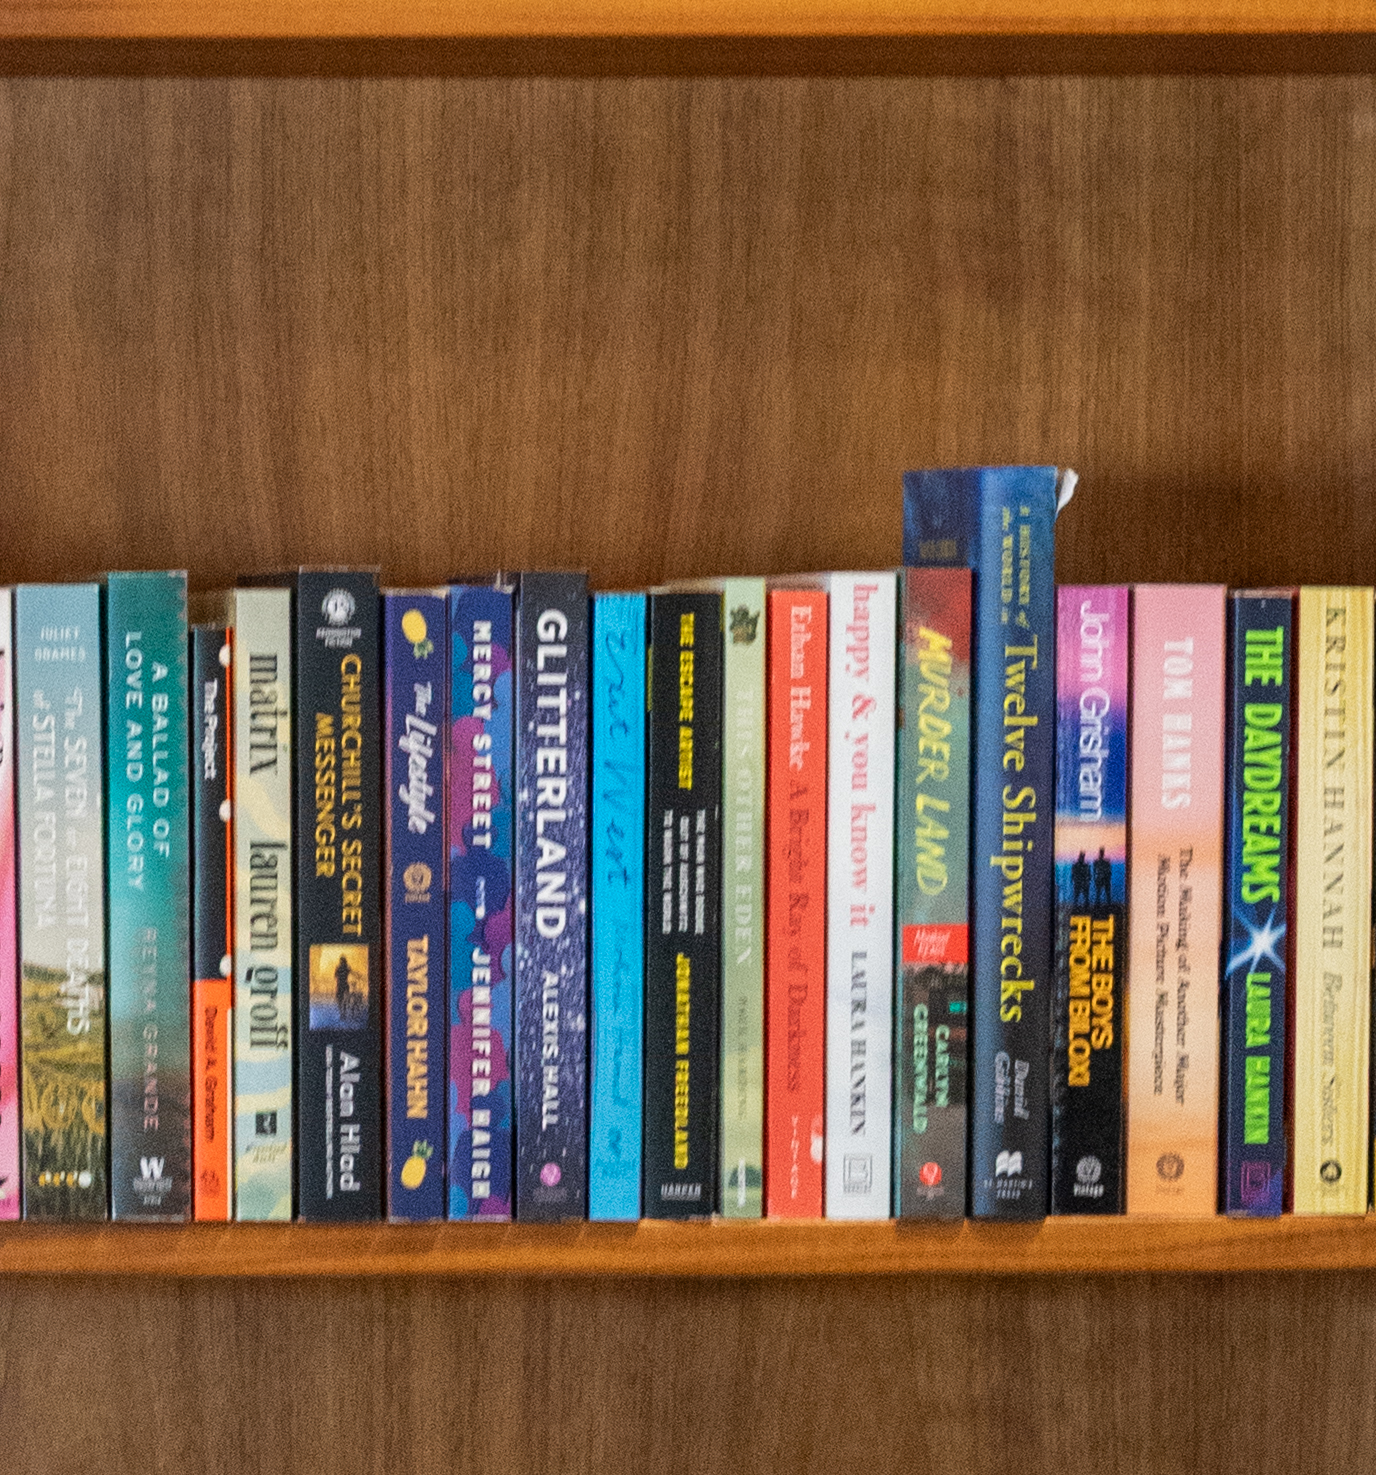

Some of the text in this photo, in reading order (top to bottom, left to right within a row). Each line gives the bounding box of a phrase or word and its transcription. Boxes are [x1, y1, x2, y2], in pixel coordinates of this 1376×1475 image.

[125, 630, 146, 893] LOVE AND GLORY
[151, 662, 170, 858] A BALLAD OF
[314, 712, 336, 879] MESSENGER
[339, 654, 362, 937] CHURCHILL'S SECRET
[915, 626, 955, 784] MURDER
[1077, 600, 1111, 822] John Grisham
[1161, 637, 1194, 810] TOM HANKS
[245, 653, 289, 1051] matrix lauren groff
[397, 682, 436, 1119] The Lifestyle TAYLOR HAHN
[471, 620, 492, 1200] MERCY STREET JENNIFER HAIGH
[534, 608, 568, 1131] GLITTERLAND ALEXIS HALL
[842, 583, 879, 1137] happy & you know it LAURA HANKIN
[914, 793, 950, 897] LAND
[990, 633, 1039, 1023] Twelve Shipwrecks
[141, 928, 159, 1131] REYNA GRANDE
[1068, 915, 1090, 1086] FROM BILOXI
[1090, 916, 1114, 1050] THE BOYS
[337, 1050, 360, 1192] Alan Hlad
